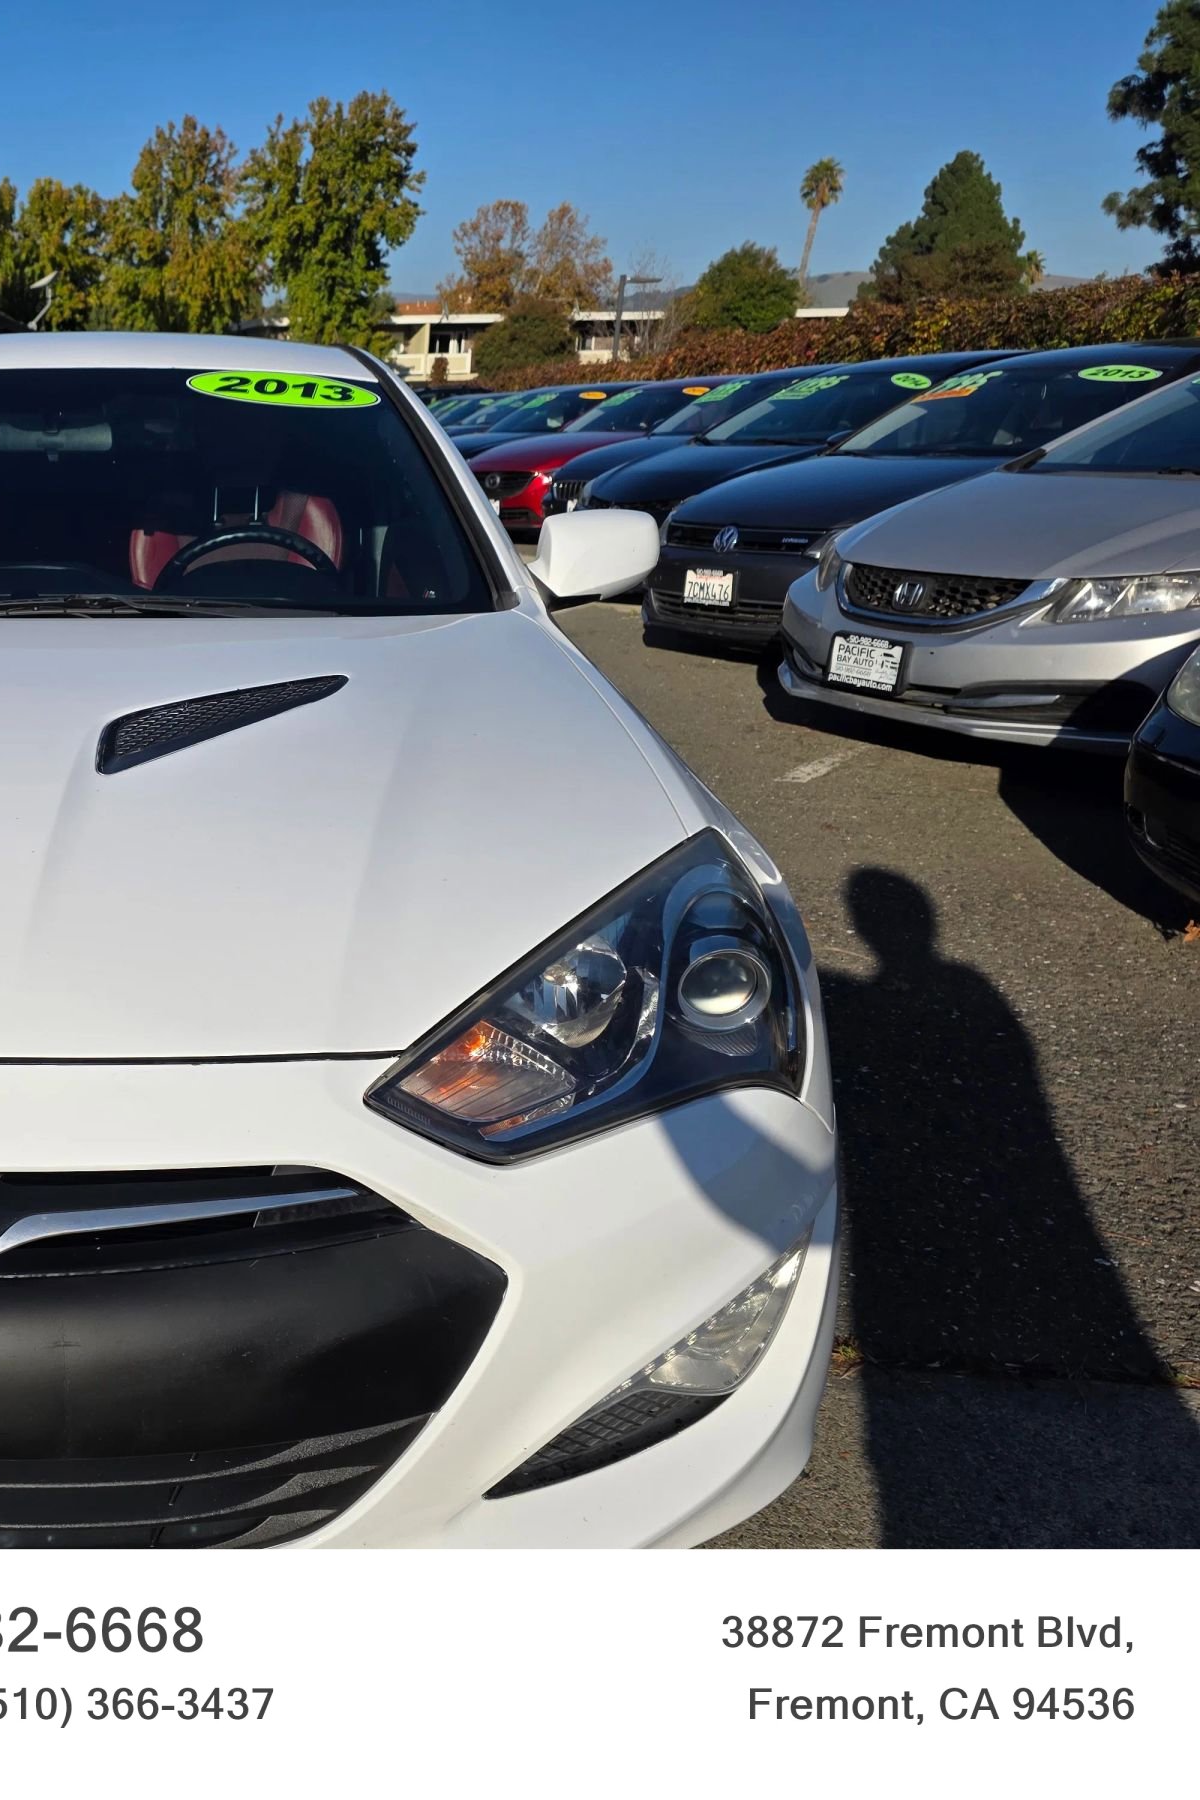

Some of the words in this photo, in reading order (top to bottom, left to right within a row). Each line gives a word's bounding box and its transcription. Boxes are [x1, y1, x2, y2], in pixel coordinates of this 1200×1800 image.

[1086, 368, 1151, 379] 2013
[214, 376, 355, 402] 2013
[687, 581, 730, 600] 7CMX476
[838, 644, 876, 659] PACIFIC
[836, 654, 852, 663] BAY
[853, 657, 874, 667] AUTO
[828, 672, 893, 692] pacificbayauto.com
